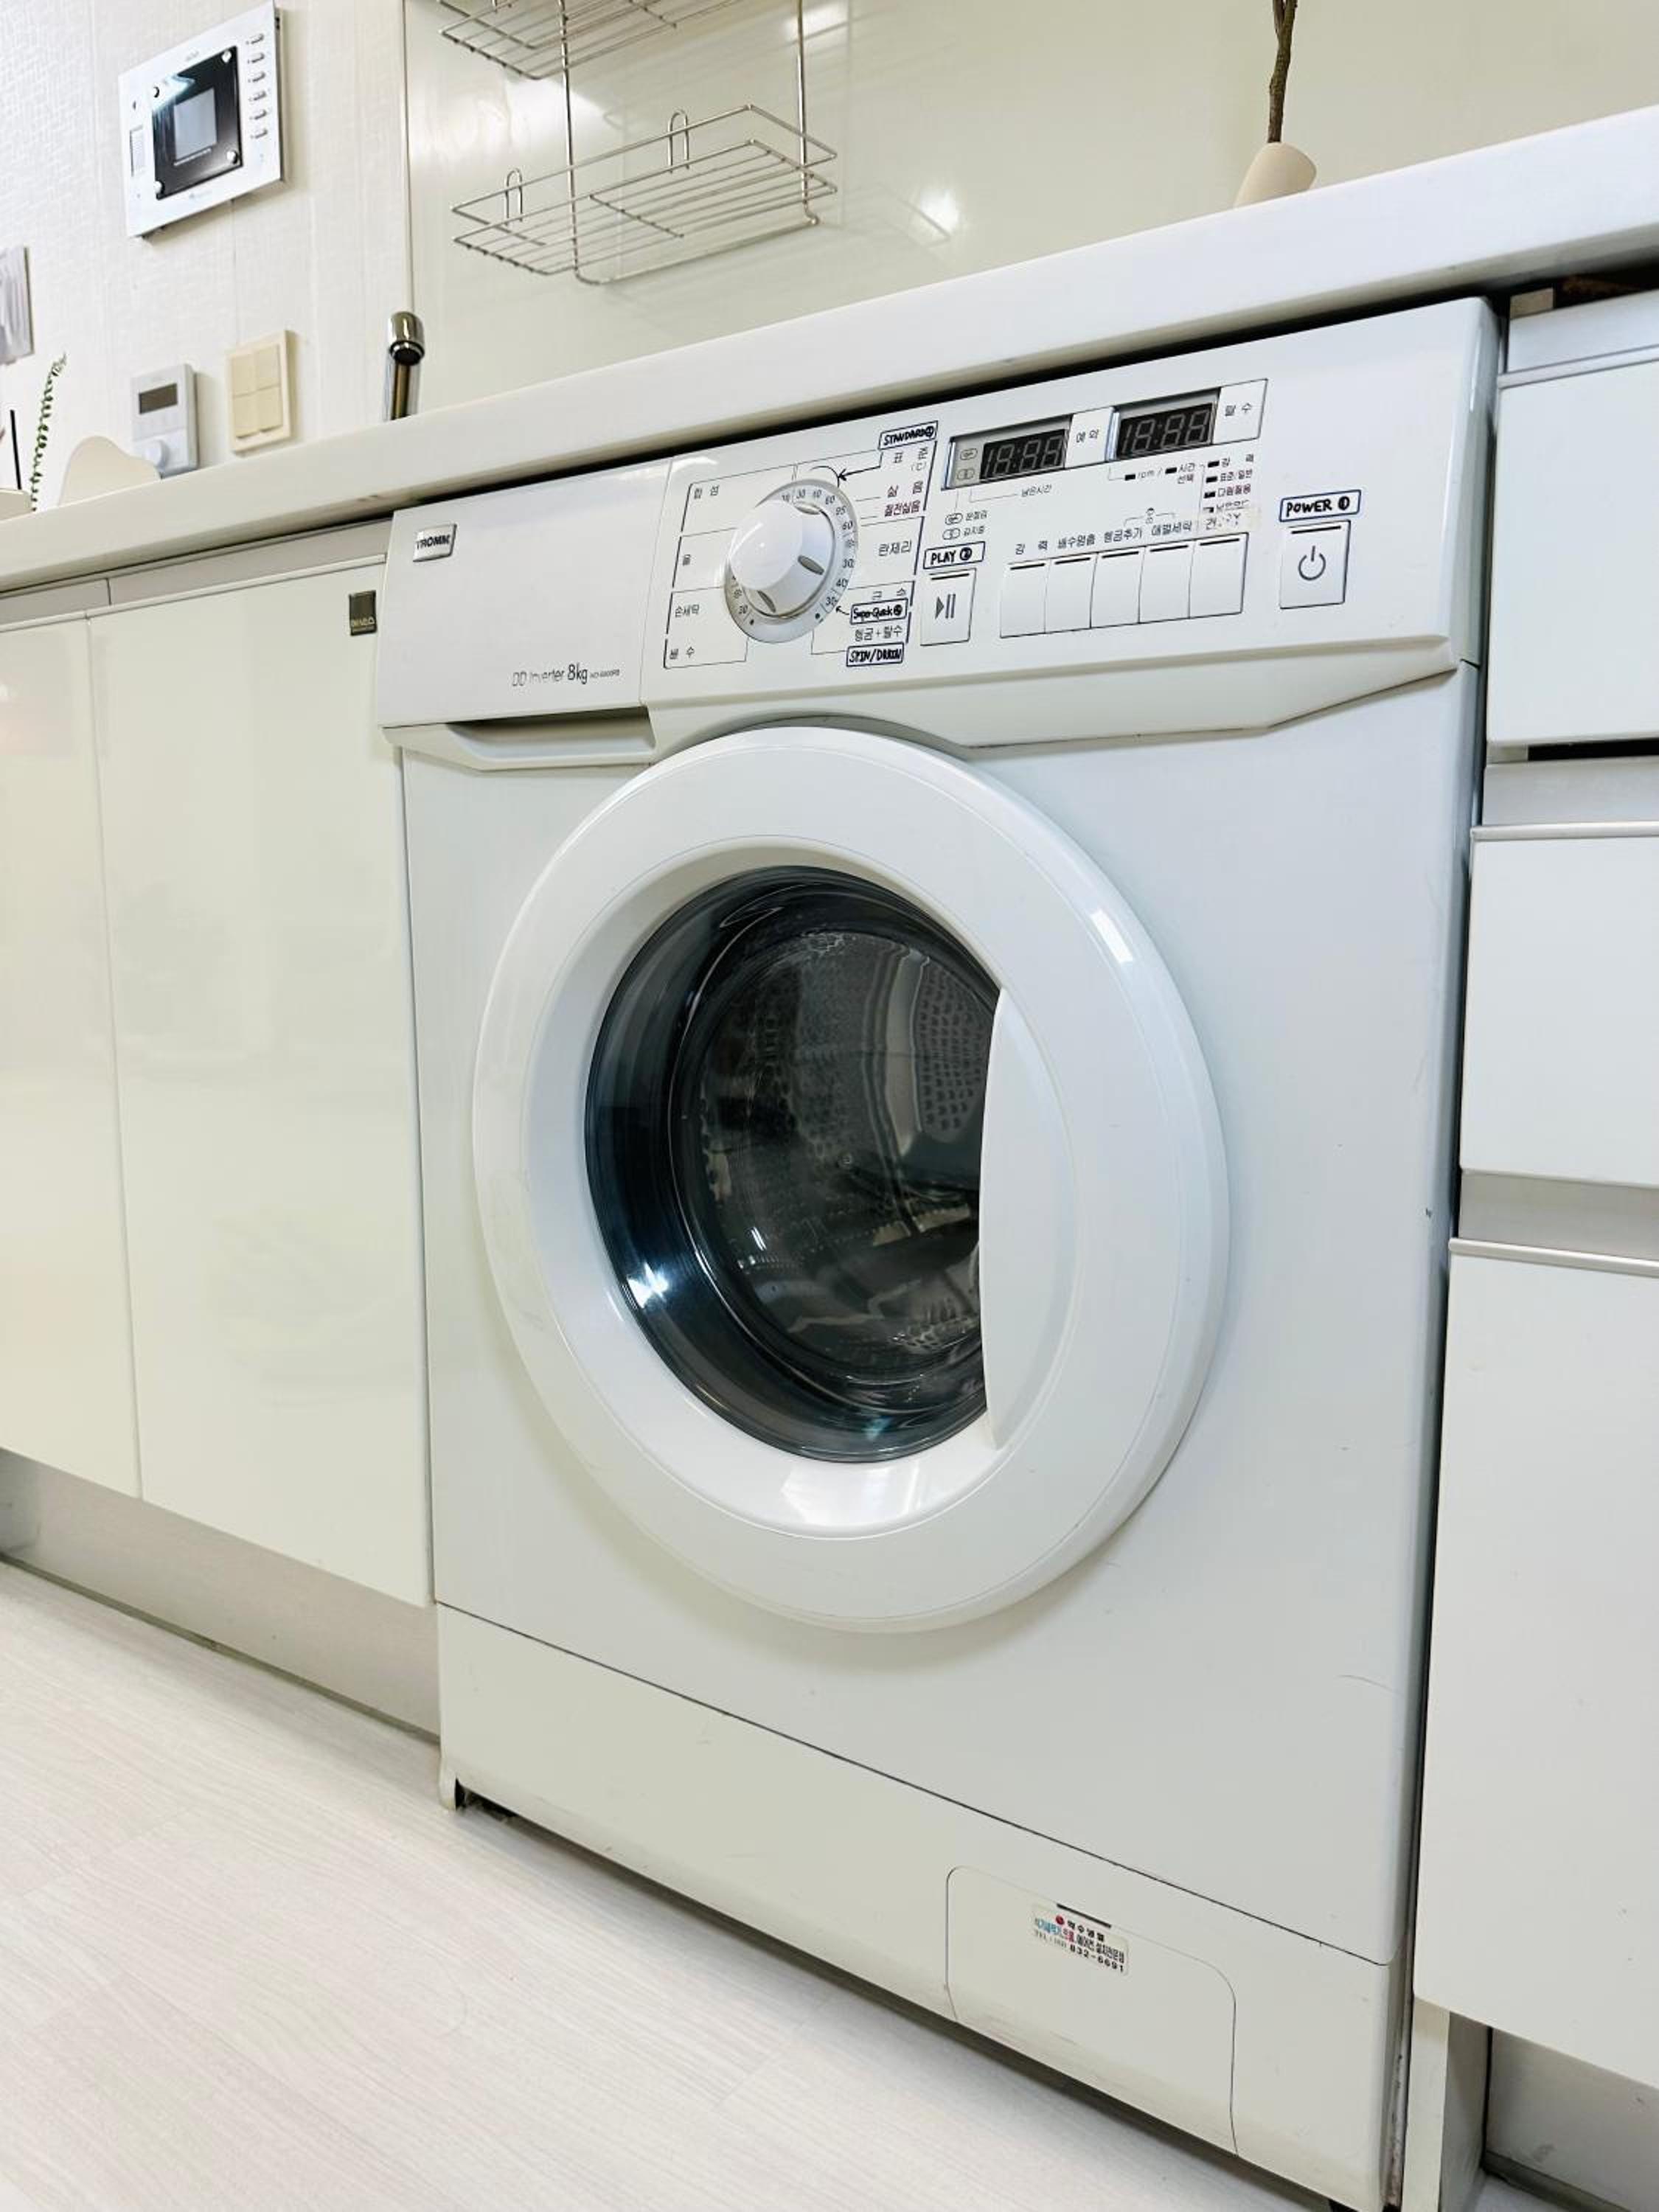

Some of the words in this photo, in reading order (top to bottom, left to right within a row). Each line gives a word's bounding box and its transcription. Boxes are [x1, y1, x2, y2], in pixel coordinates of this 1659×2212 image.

[1286, 498, 1332, 518] POWER
[931, 549, 956, 566] PLAY
[568, 662, 588, 684] 8kg
